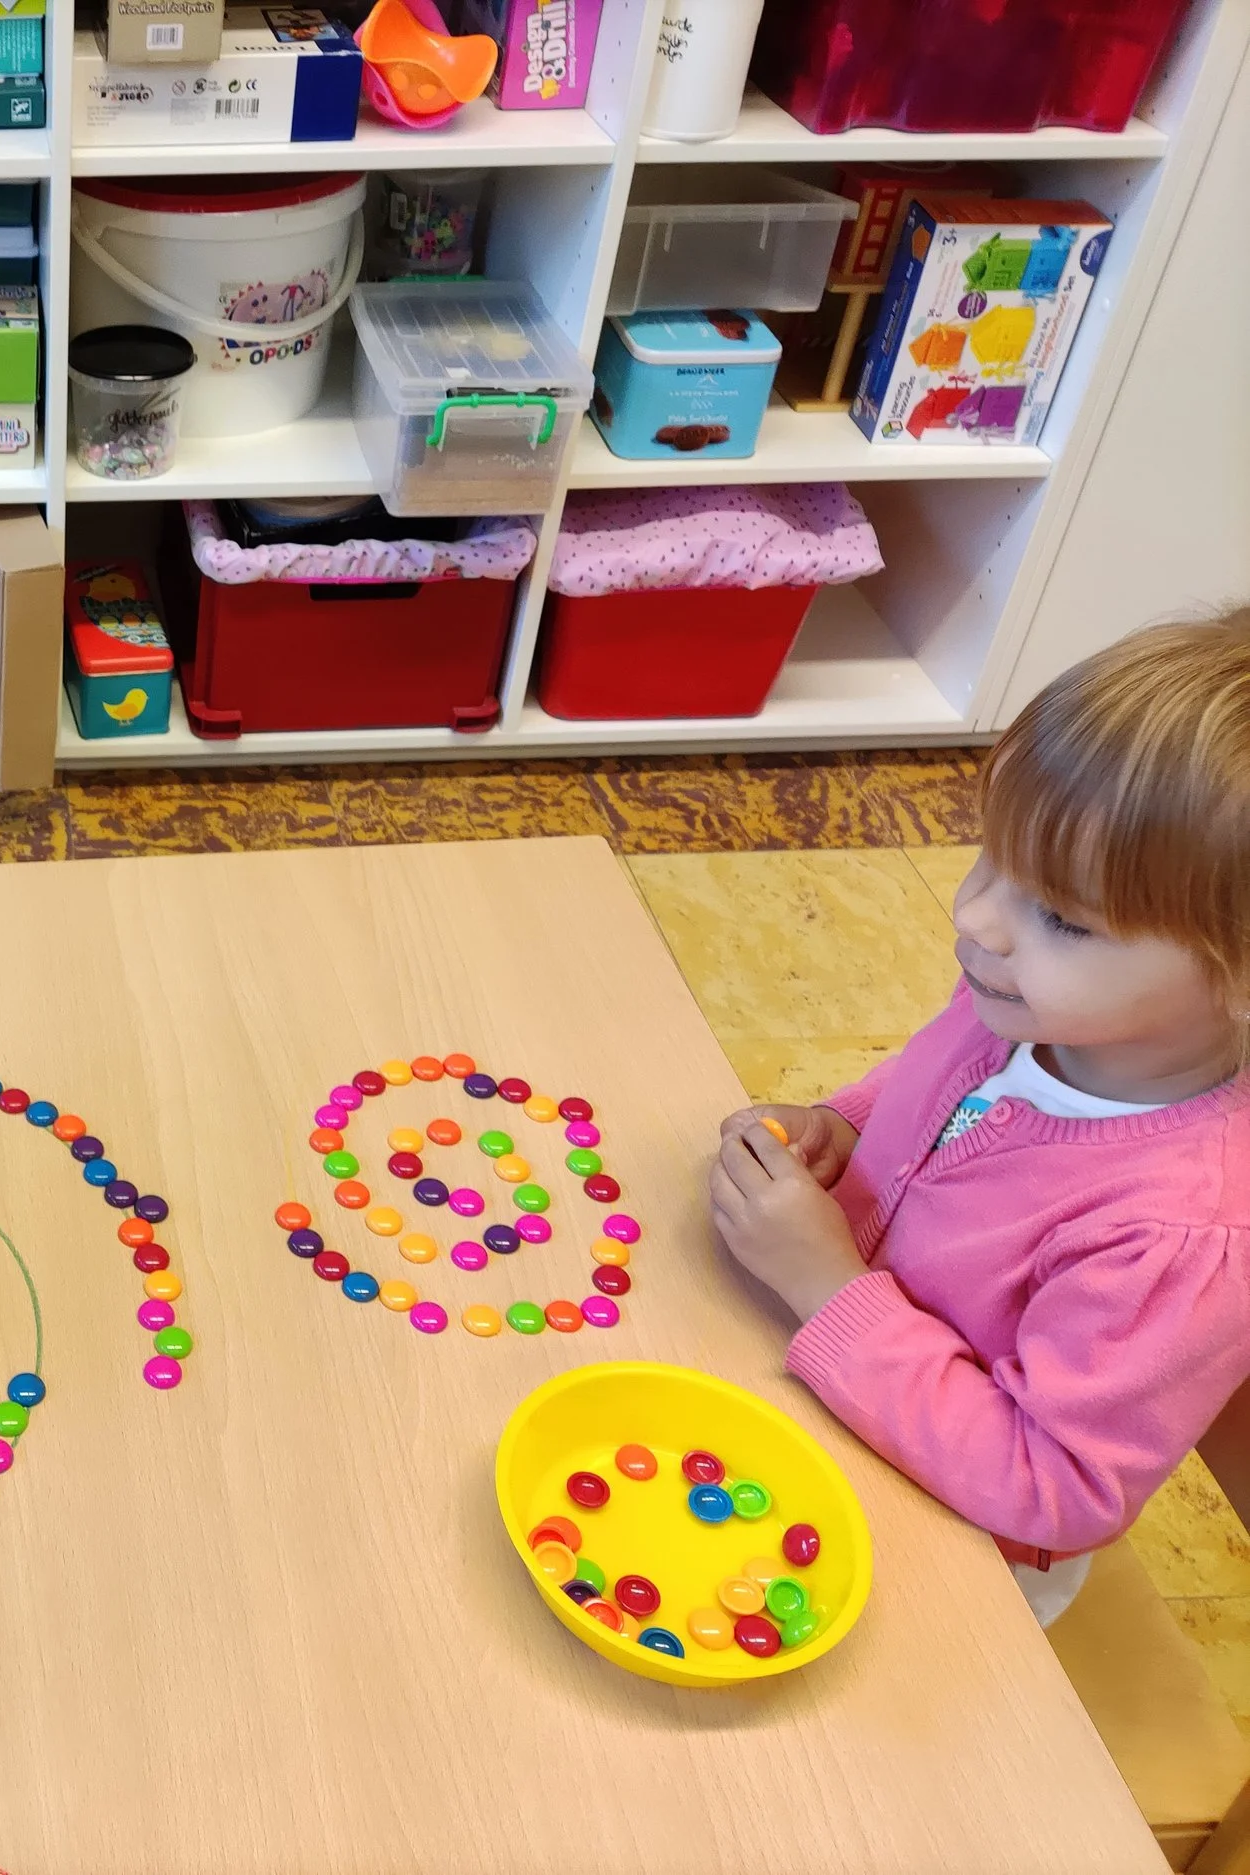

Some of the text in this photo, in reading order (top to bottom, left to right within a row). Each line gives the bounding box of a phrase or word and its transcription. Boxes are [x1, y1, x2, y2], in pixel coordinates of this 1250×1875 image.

[523, 12, 547, 93] Design
[542, 0, 567, 63] Drill
[942, 228, 958, 246] 3+
